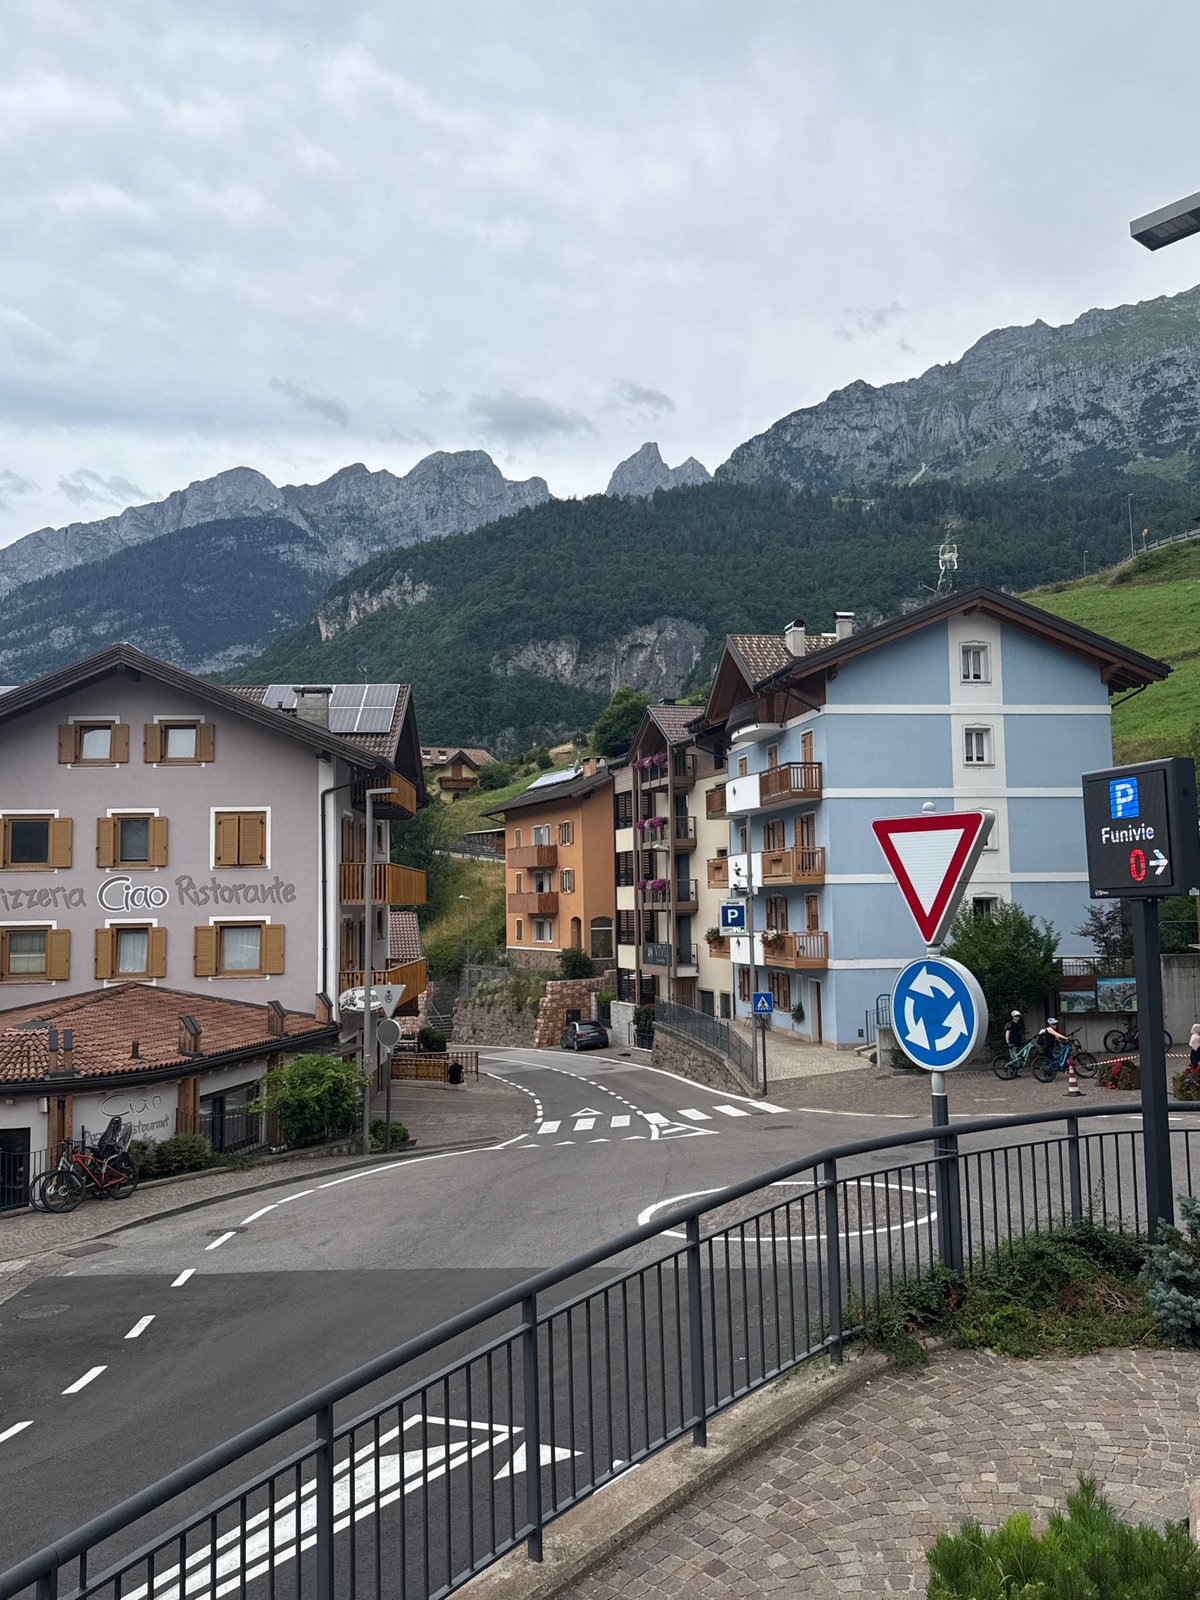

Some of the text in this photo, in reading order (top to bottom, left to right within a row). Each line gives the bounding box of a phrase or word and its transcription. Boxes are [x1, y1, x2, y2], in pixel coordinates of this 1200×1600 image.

[1115, 783, 1134, 817] P
[1101, 823, 1155, 844] Funivie
[1129, 848, 1146, 881] 0
[0, 874, 297, 912] izzeria Ciao Ristorante
[727, 909, 739, 923] P
[101, 1094, 162, 1117] Ciao
[132, 1114, 169, 1135] staurant
